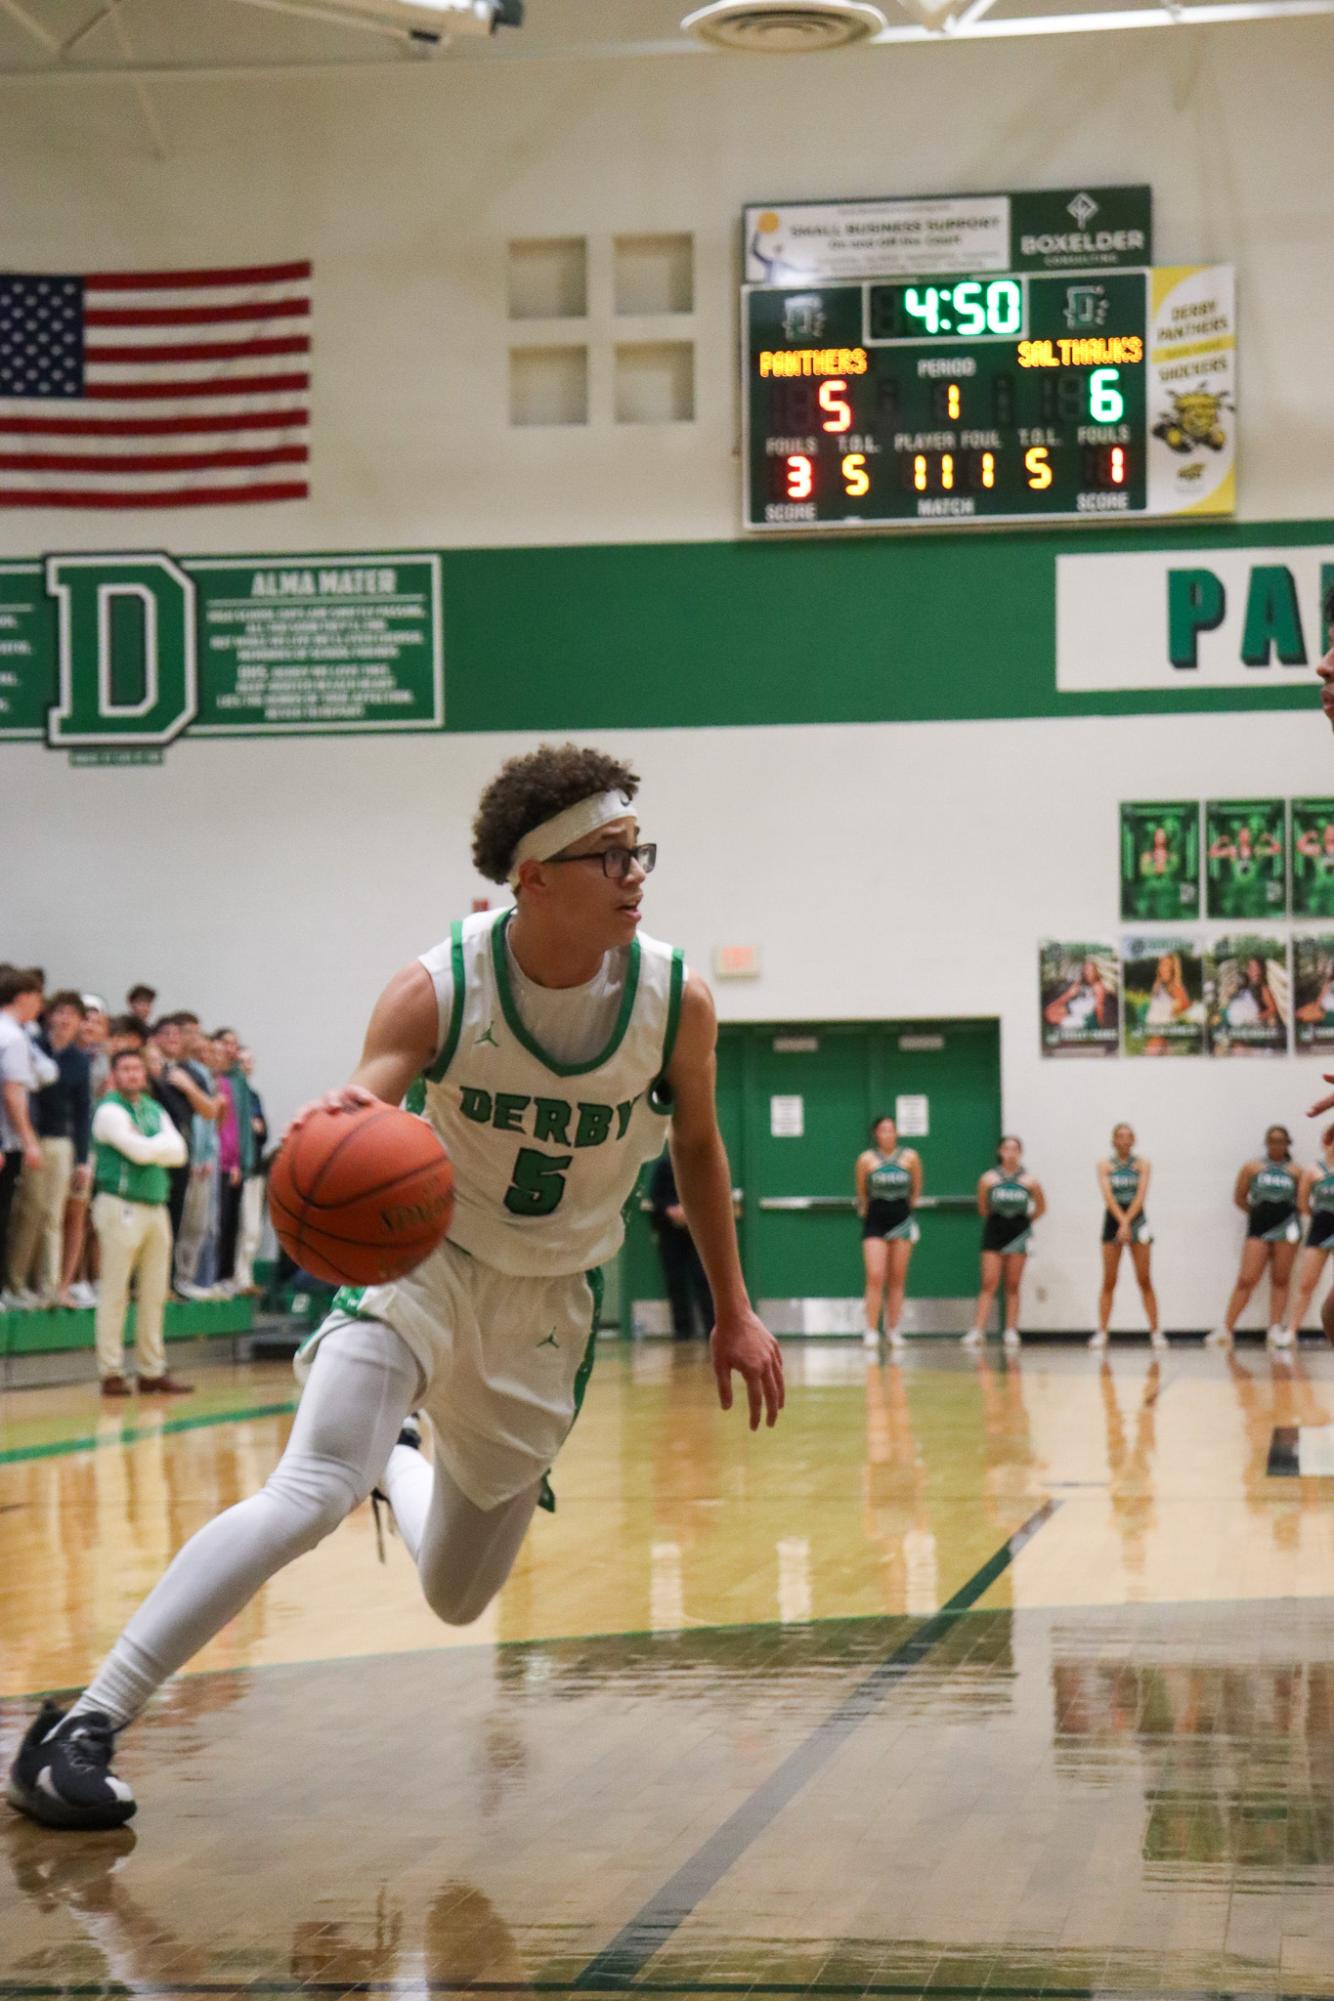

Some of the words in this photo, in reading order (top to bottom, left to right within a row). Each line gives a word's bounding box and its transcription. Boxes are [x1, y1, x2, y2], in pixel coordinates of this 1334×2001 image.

[927, 214, 1001, 231] SUPPORT
[1021, 229, 1145, 255] BOXELDER
[904, 280, 1021, 335] 4:50
[1171, 299, 1217, 322] DERBY
[1156, 317, 1229, 343] PANTHERS
[759, 347, 867, 378] PANTHERS
[917, 356, 976, 378] PERIOD
[819, 379, 852, 433] 5
[948, 383, 960, 420] 1
[1089, 367, 1124, 423] 6
[765, 435, 818, 456] FOULS
[894, 430, 957, 452] PLAYER
[960, 428, 1003, 450] FOUL
[1077, 423, 1130, 446] FOULS
[787, 455, 812, 498] 3
[841, 453, 870, 497] 5
[1025, 446, 1053, 490] 5
[1111, 447, 1124, 484] 1
[765, 503, 817, 523] SCORE
[917, 497, 976, 517] MATCH
[1076, 491, 1130, 513] SCORE
[251, 570, 316, 596] ALMA
[318, 567, 397, 595] MATER
[47, 552, 198, 746] D
[459, 1085, 645, 1148] DERBY
[503, 1147, 574, 1217] 5
